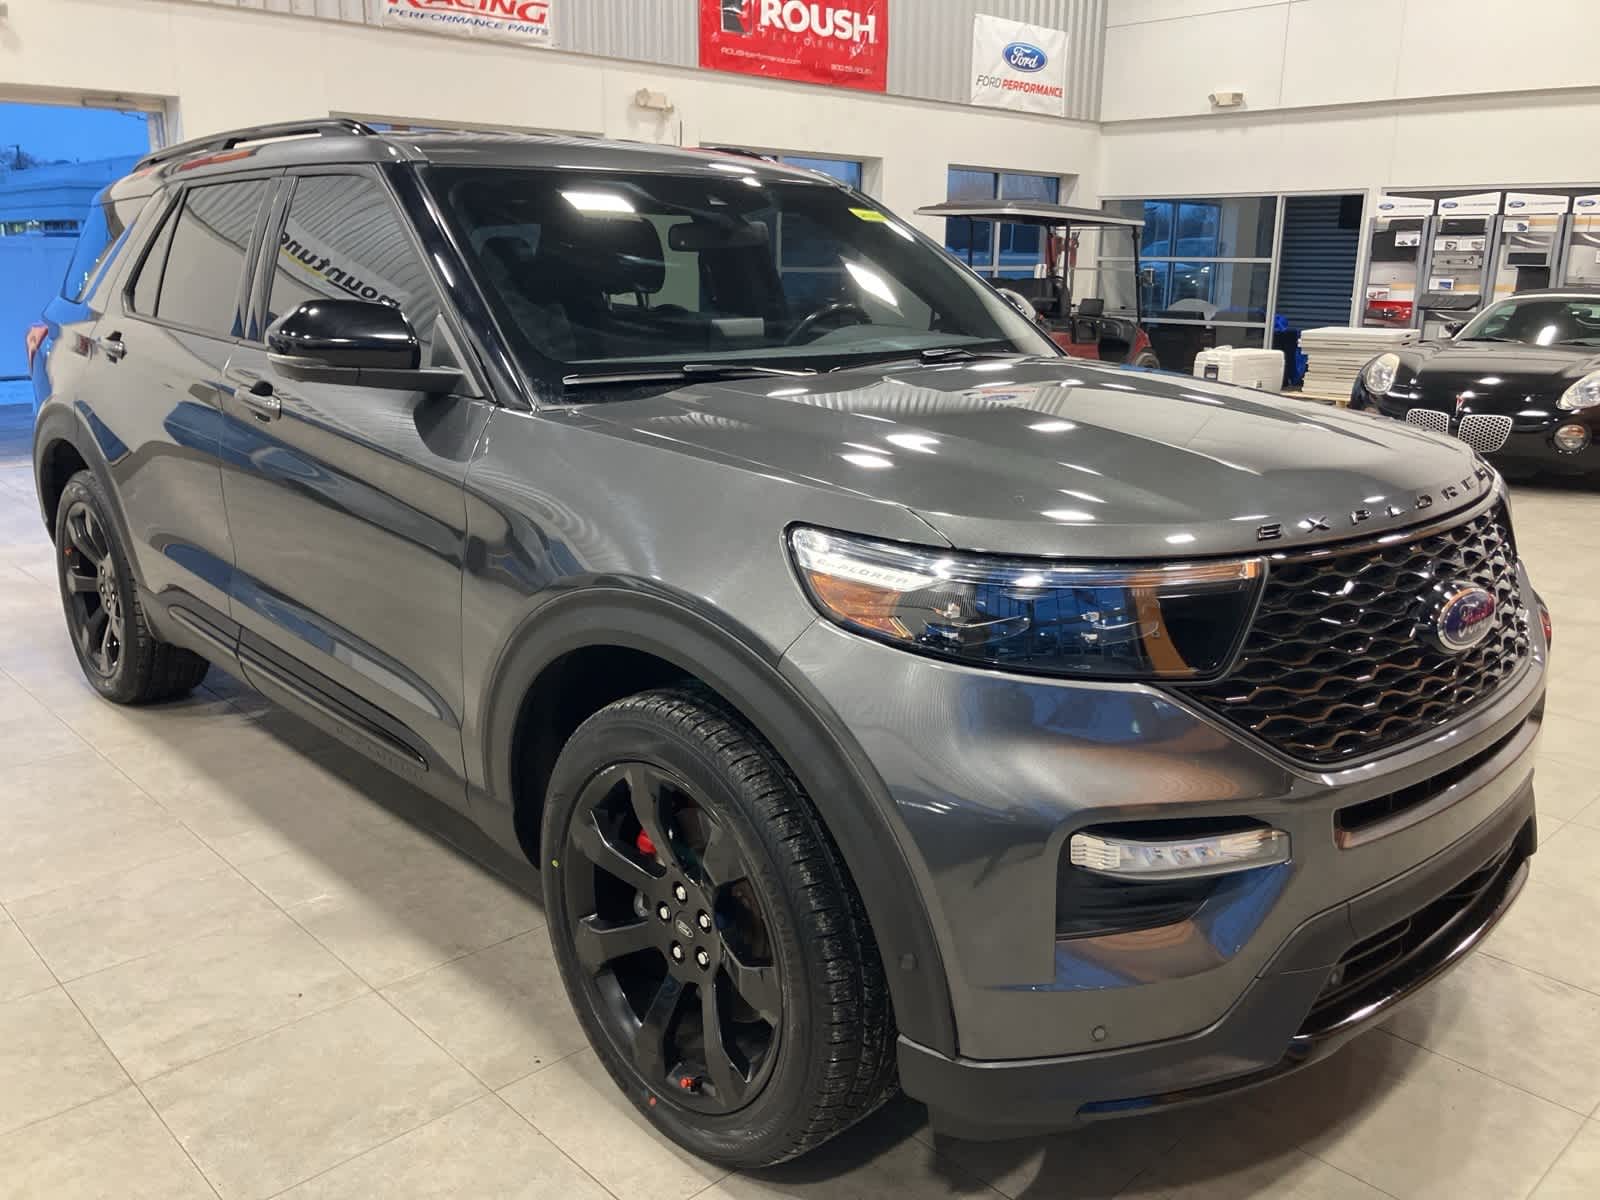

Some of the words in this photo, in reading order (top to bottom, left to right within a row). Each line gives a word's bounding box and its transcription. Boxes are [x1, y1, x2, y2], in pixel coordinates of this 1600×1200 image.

[386, 0, 549, 24] CING
[388, 7, 503, 29] PERFORMANCE
[507, 24, 549, 36] PARTS
[760, 0, 876, 44] ROUSH
[1010, 46, 1039, 69] Ford
[976, 75, 1001, 88] FORD
[1001, 79, 1063, 98] PERFORMANCE
[817, 558, 909, 584] EPLORER
